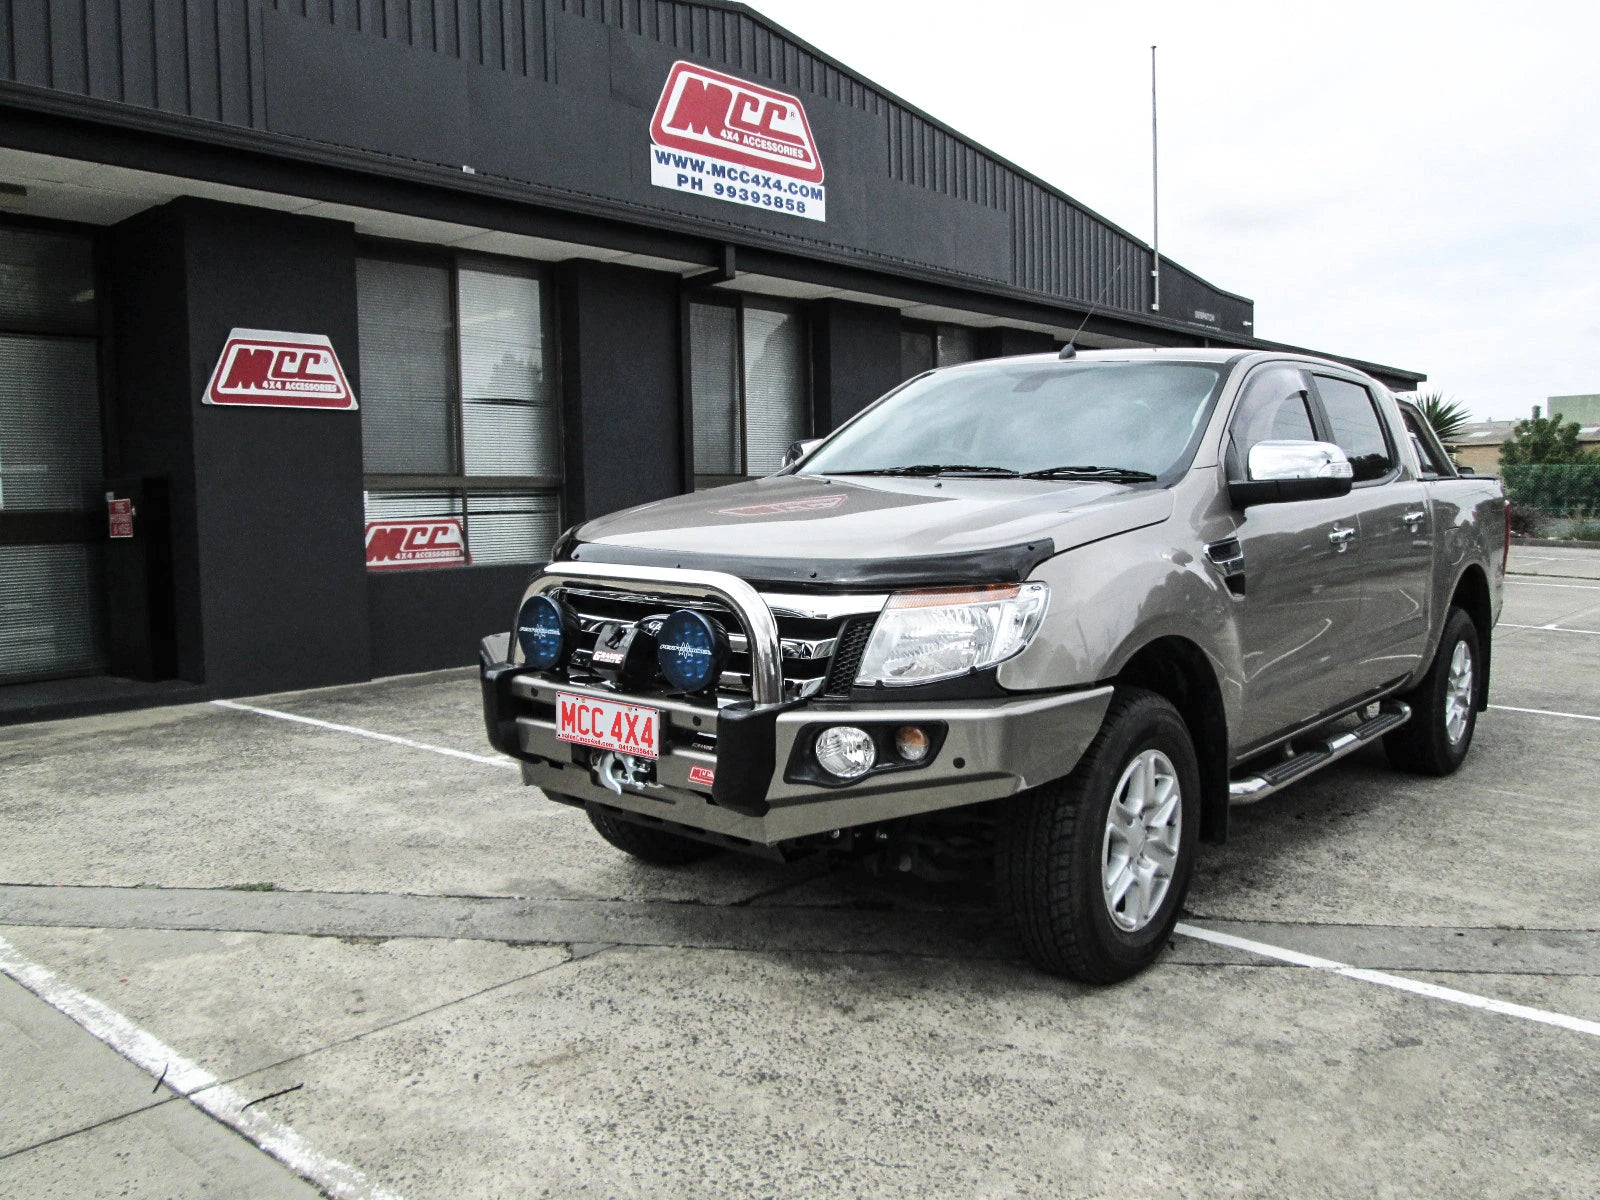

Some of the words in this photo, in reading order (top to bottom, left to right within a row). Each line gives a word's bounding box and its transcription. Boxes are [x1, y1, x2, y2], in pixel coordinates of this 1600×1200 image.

[667, 77, 806, 146] MCC
[720, 129, 740, 142] 4X4
[743, 134, 804, 159] ACCESSORIES
[655, 150, 823, 201] WWW.MCC4X4.COM
[677, 173, 703, 191] PH
[713, 183, 806, 214] 99393858
[221, 348, 336, 389] MCC
[262, 380, 282, 390] 4X4
[285, 382, 338, 392] ACCESSORIES
[366, 526, 461, 562] MCC
[415, 550, 460, 559] ACCESSORIES
[561, 701, 604, 738] MCC
[610, 711, 654, 749] 4X4
